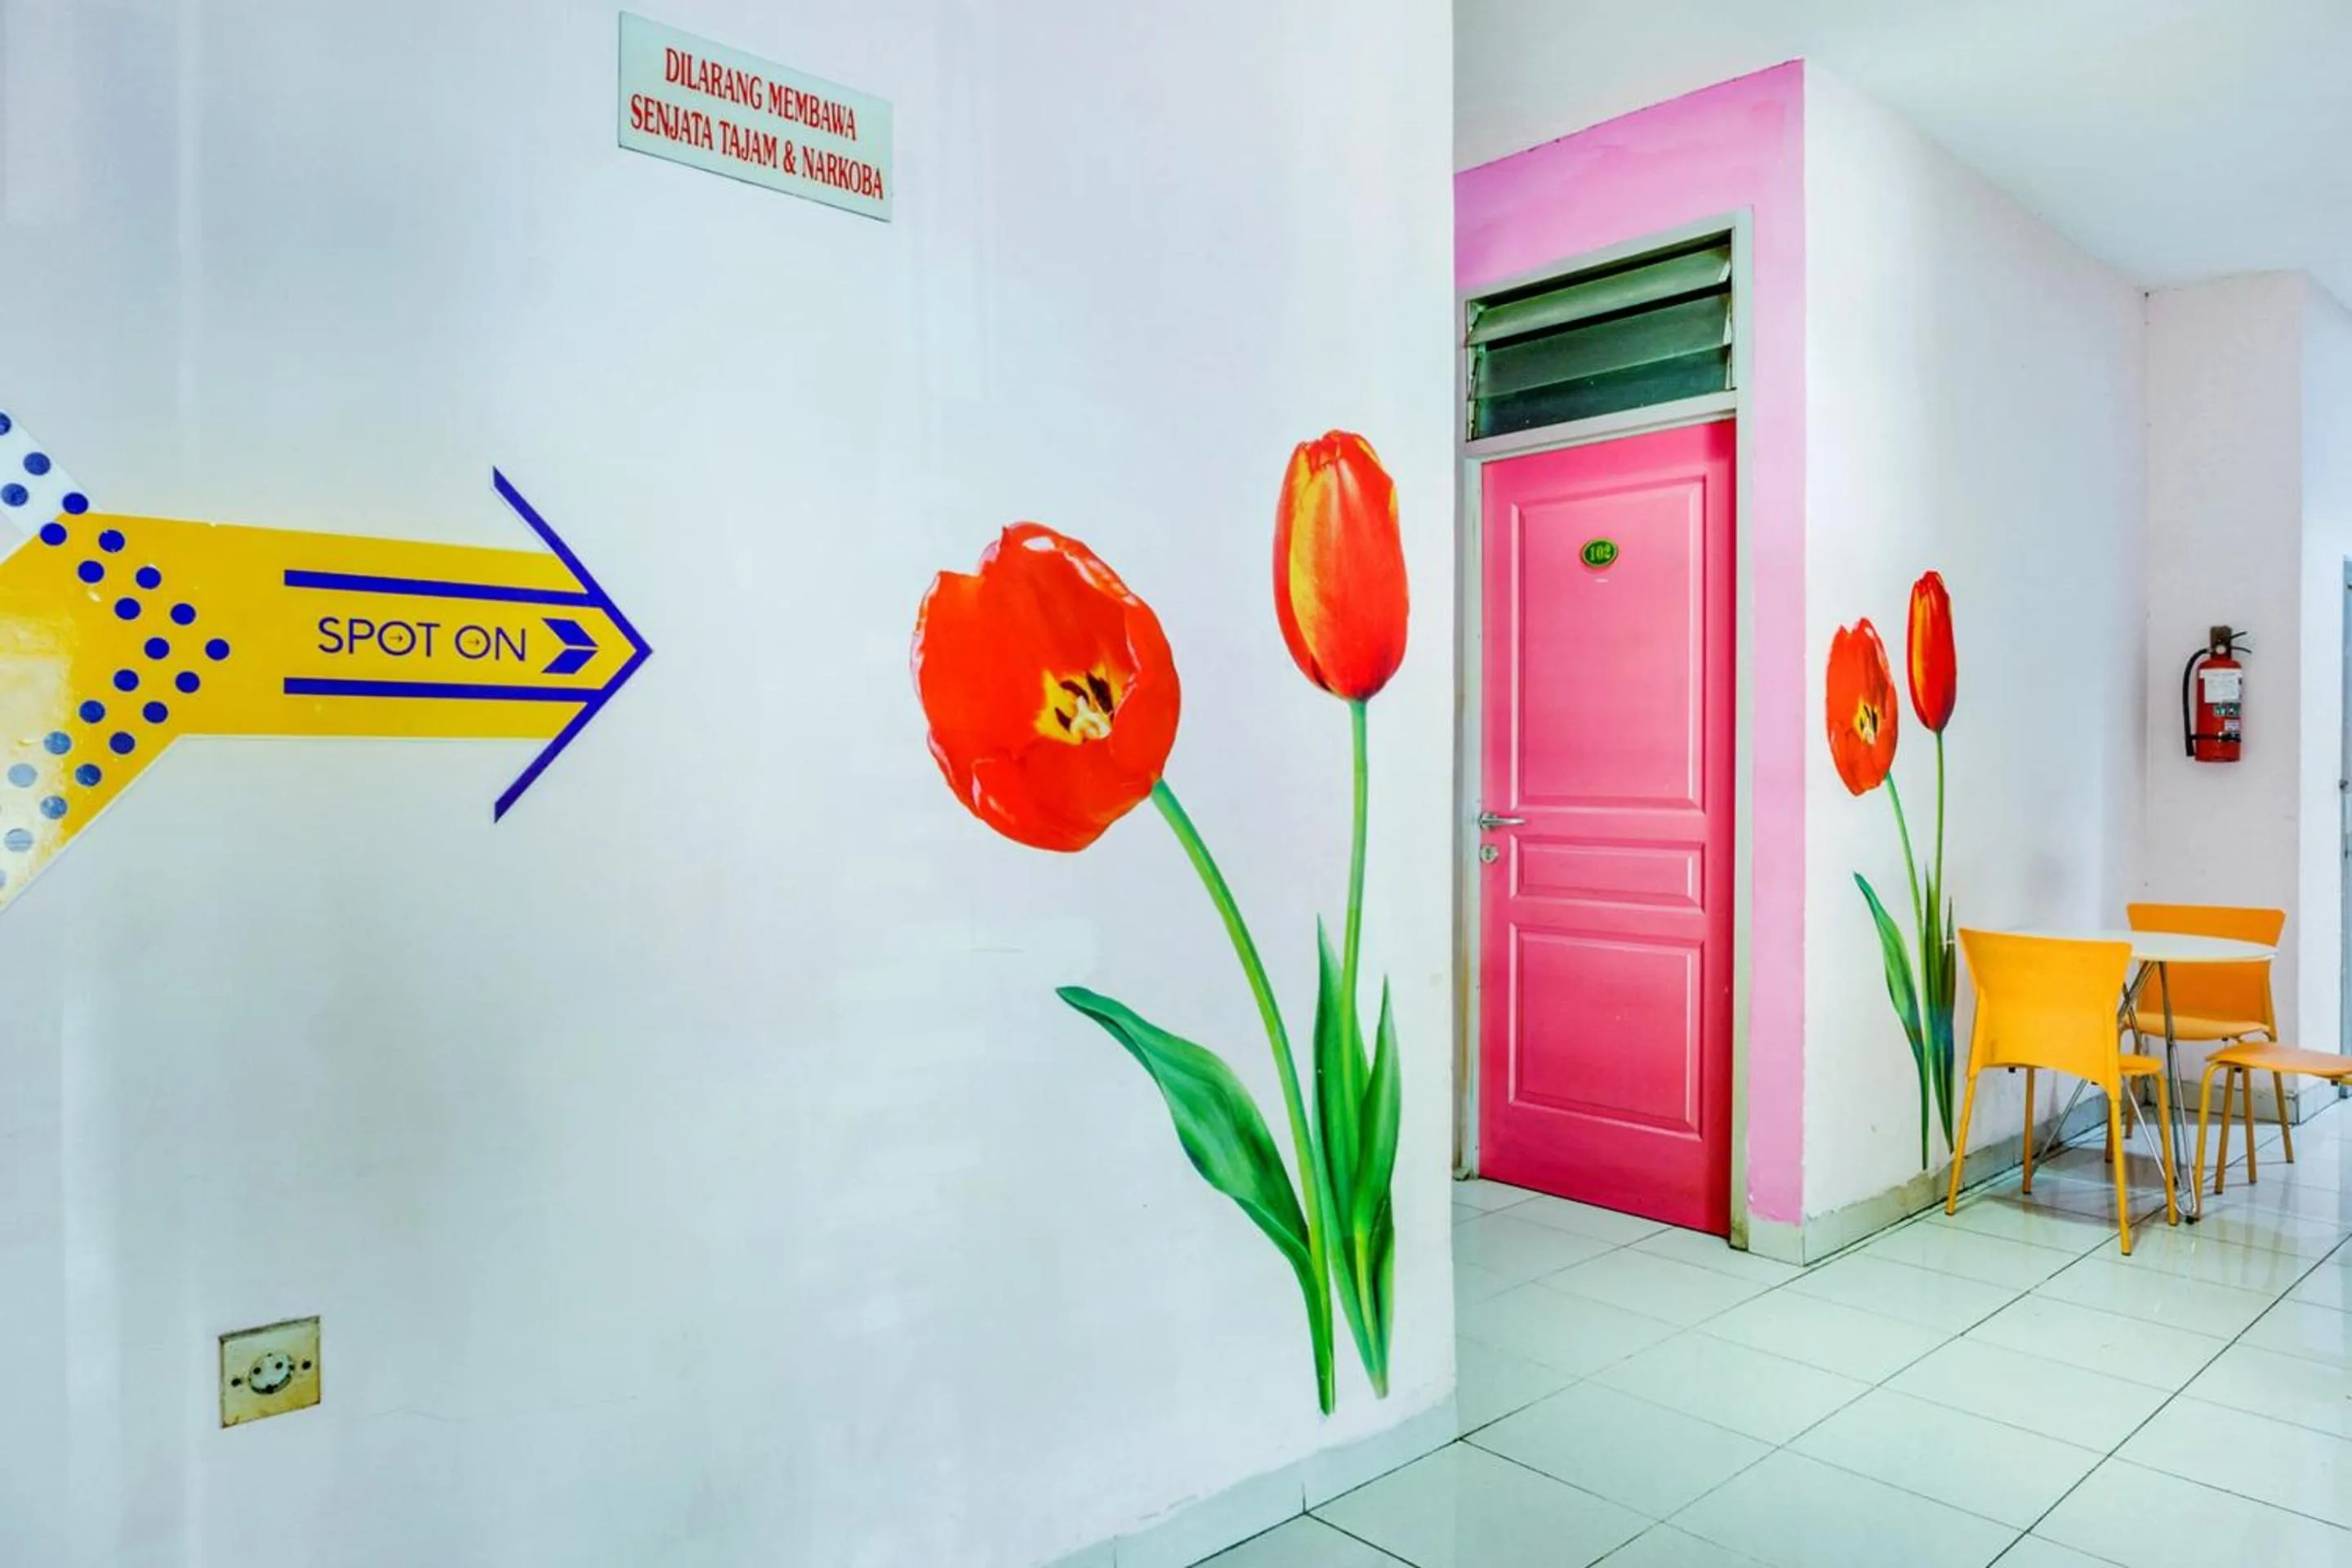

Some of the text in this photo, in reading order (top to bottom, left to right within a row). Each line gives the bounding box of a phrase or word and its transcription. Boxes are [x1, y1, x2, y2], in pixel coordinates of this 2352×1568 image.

[665, 47, 857, 141] DILARANG MEMBAWA
[630, 93, 884, 200] SENJATA TAJAM & NARKOBA
[318, 617, 526, 662] SPOT ON
